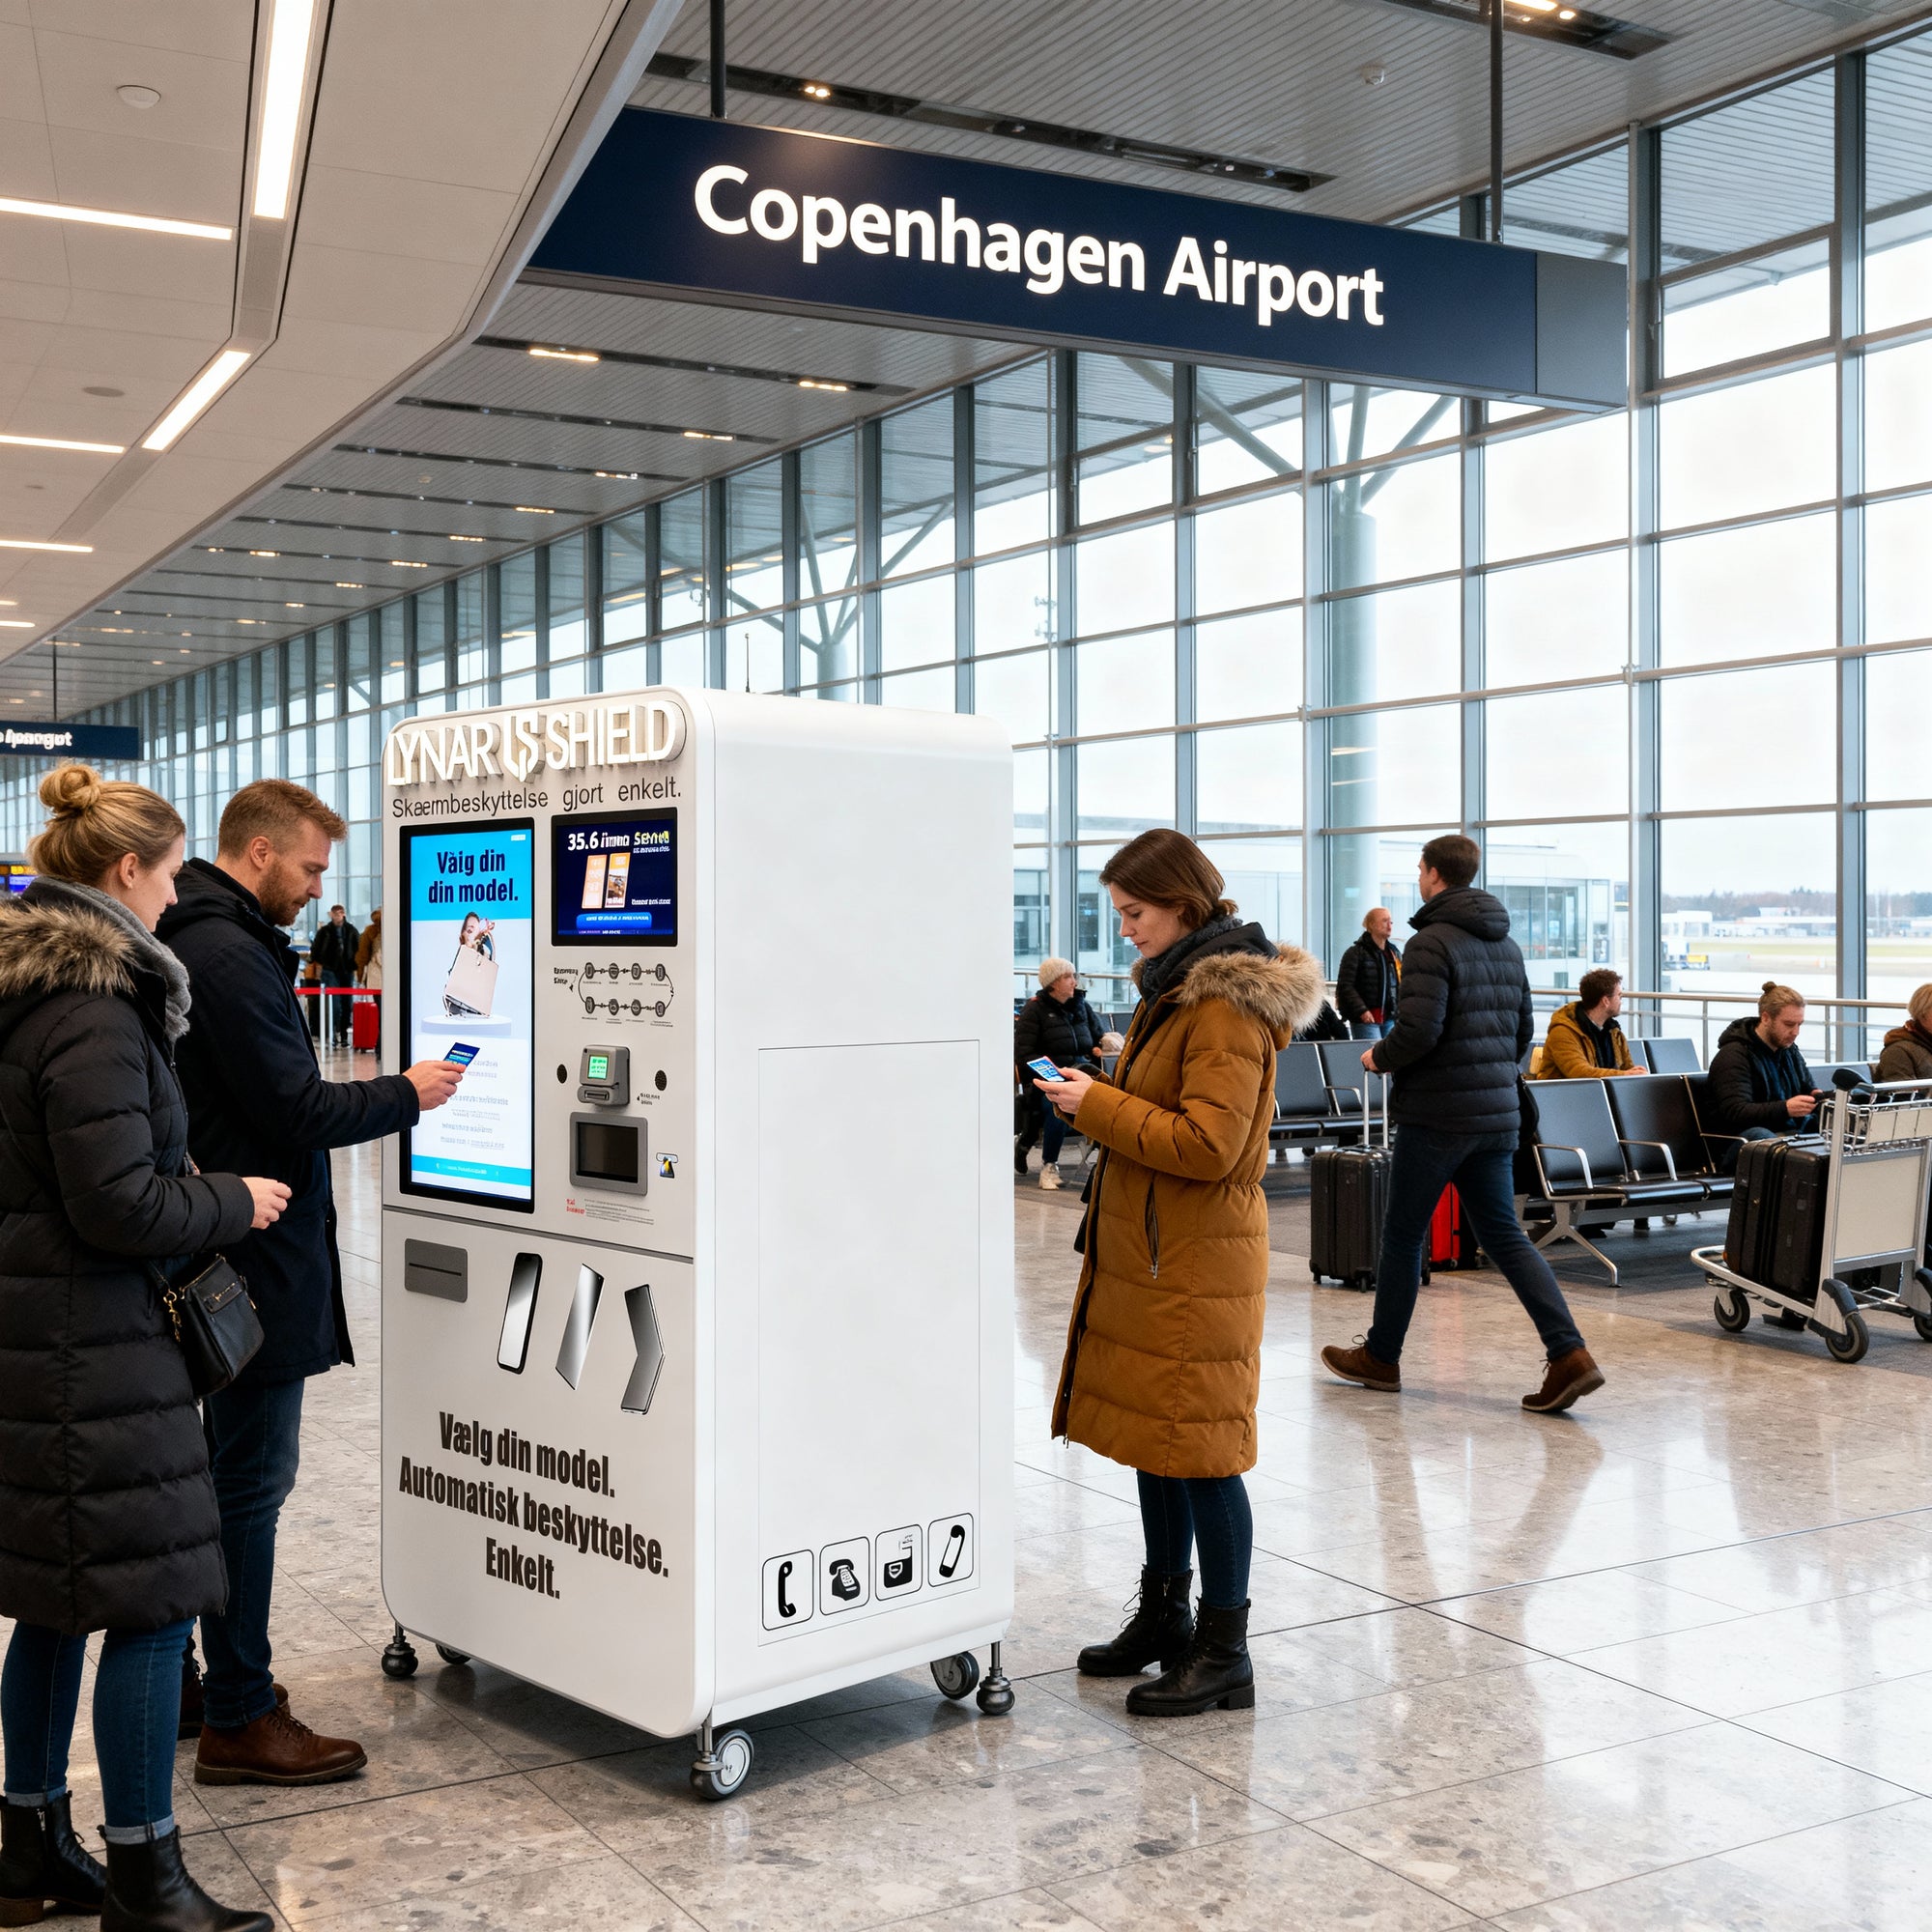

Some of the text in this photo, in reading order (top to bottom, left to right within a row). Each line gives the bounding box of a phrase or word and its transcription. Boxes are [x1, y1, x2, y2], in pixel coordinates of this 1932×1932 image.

[694, 164, 1385, 327] Copenhagen Airport
[387, 723, 501, 786] LYNAR
[546, 701, 679, 771] SHIELD
[562, 781, 605, 812] gjort
[618, 775, 682, 803] enkelt.
[428, 877, 519, 903] din model.
[479, 849, 505, 872] din
[439, 1410, 615, 1498] Vælg din model.
[398, 1455, 668, 1578] Automatisk beskyttelse.
[485, 1536, 560, 1600] Enkelt.
